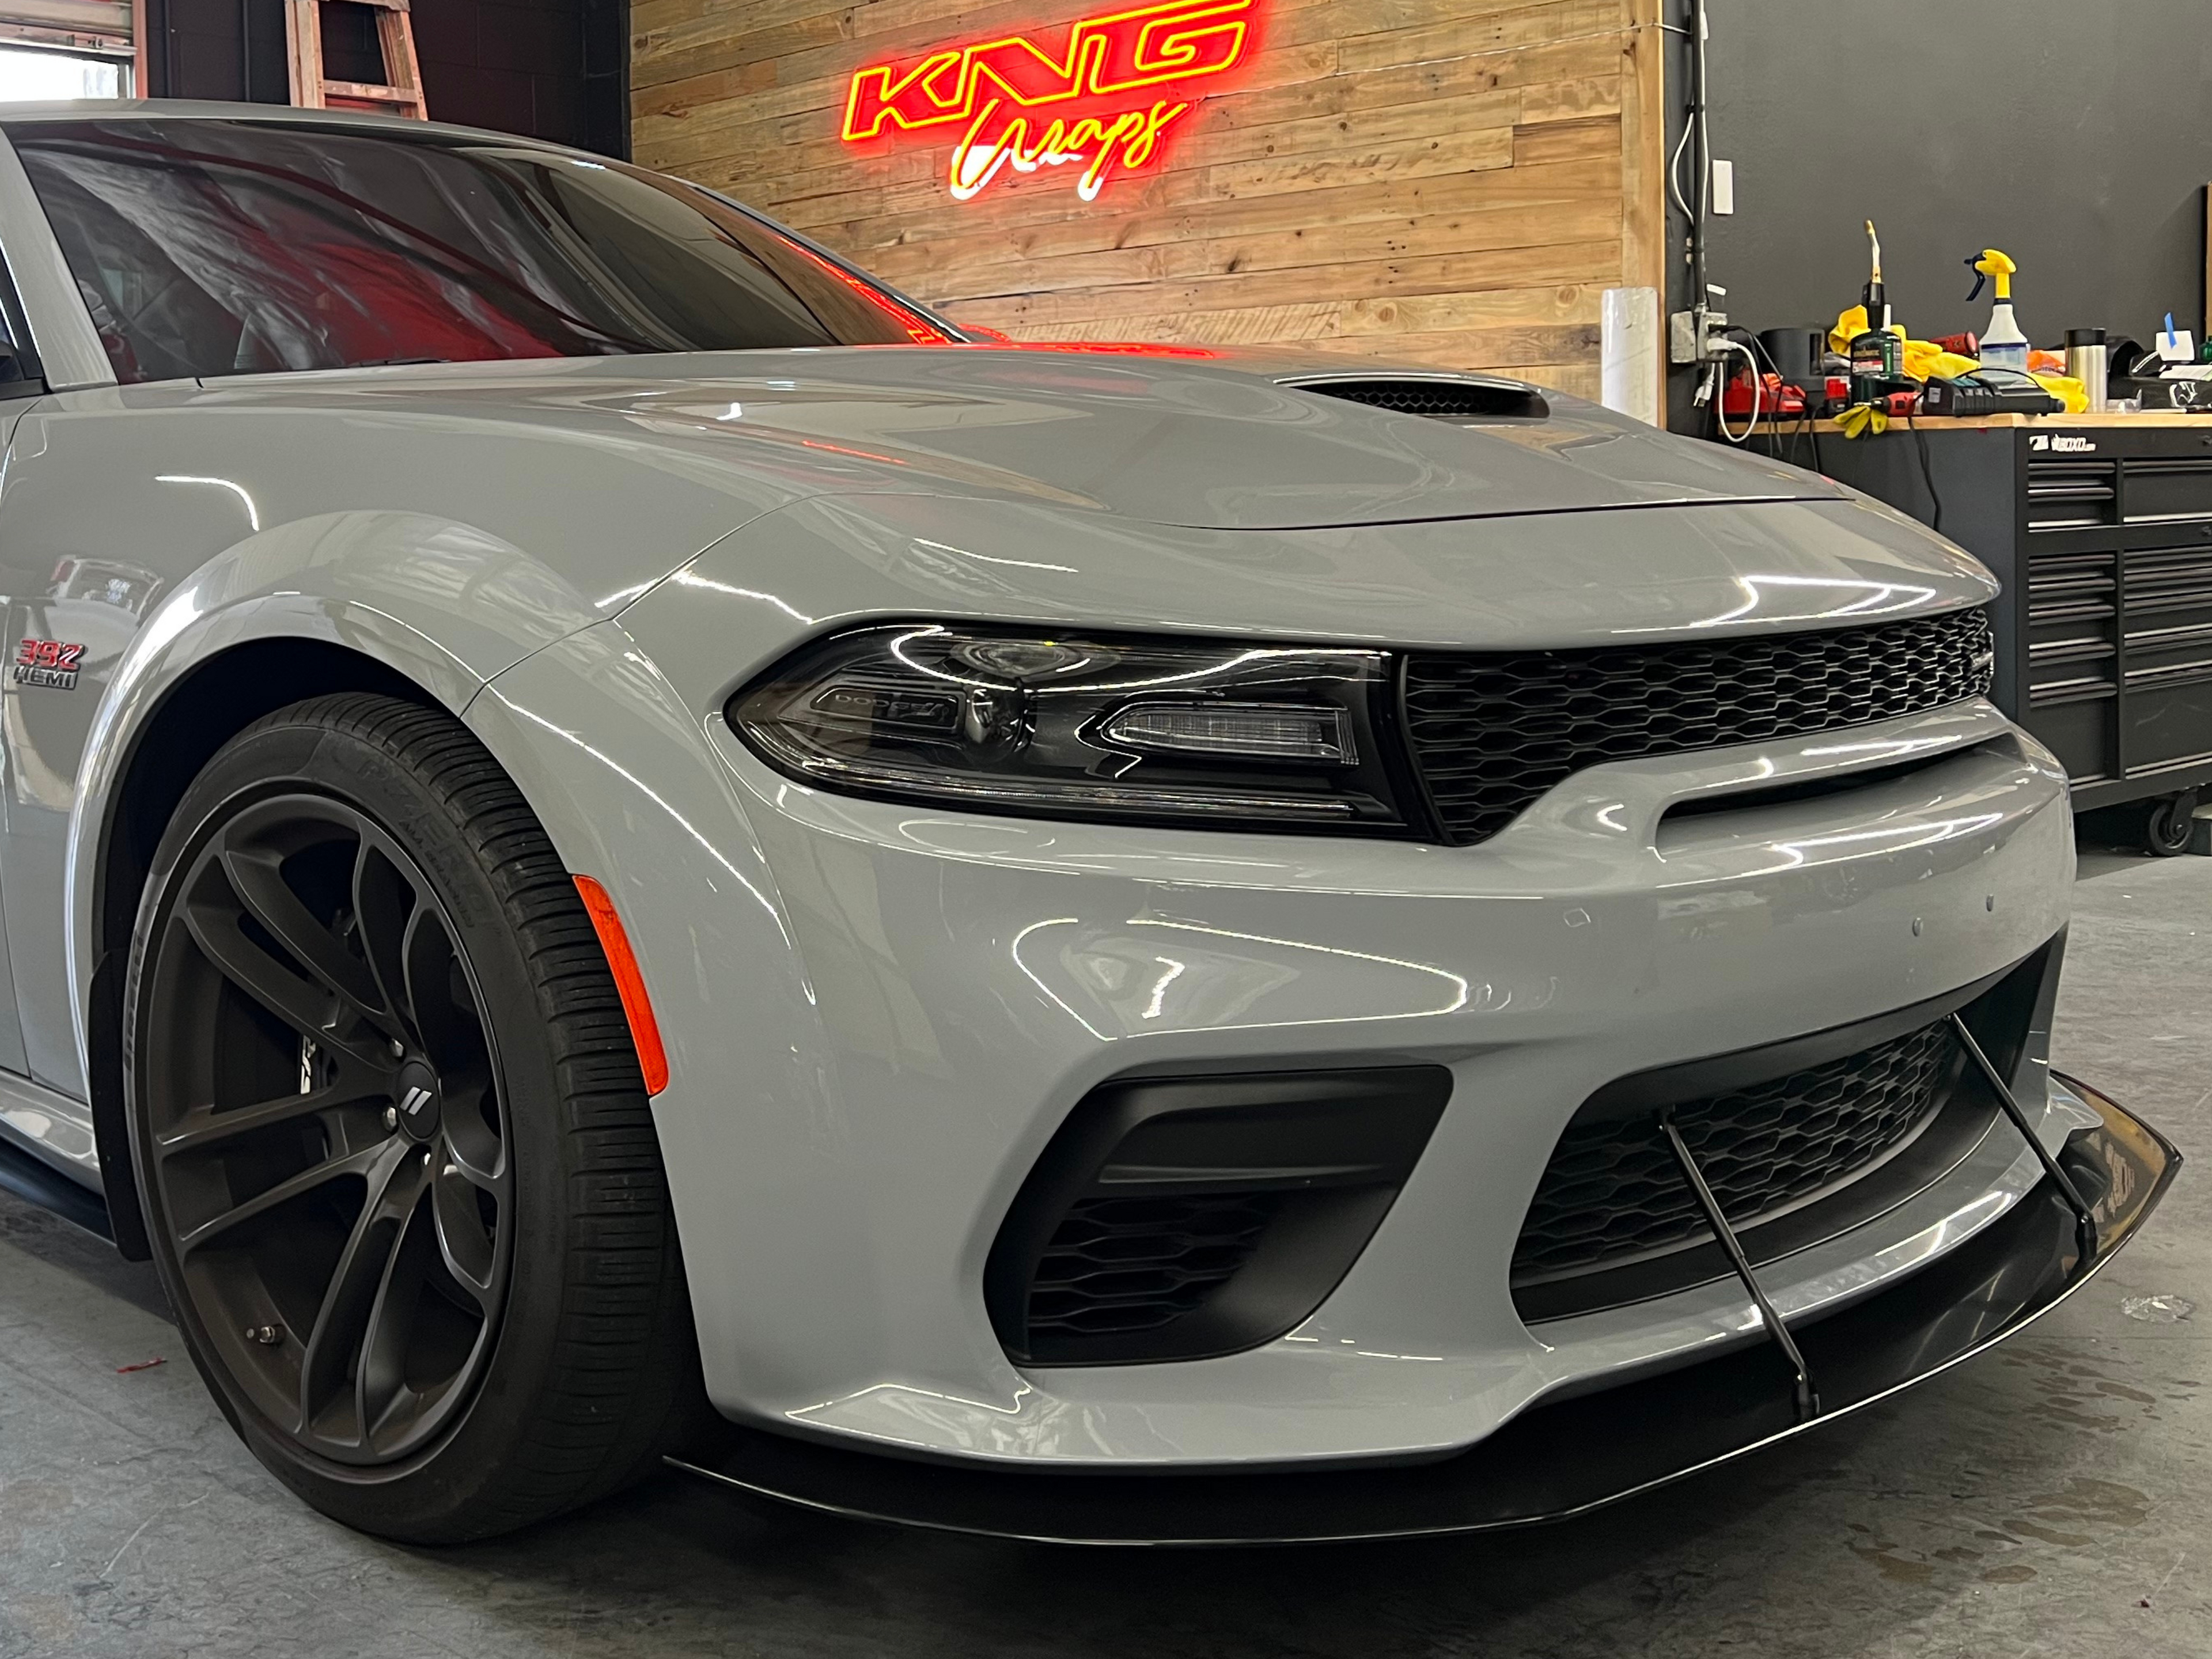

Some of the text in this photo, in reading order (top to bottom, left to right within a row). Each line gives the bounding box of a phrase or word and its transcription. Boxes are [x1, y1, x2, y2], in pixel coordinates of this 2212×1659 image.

[842, 0, 1252, 141] KNG
[16, 639, 85, 670] 392
[14, 666, 78, 690] HEMI
